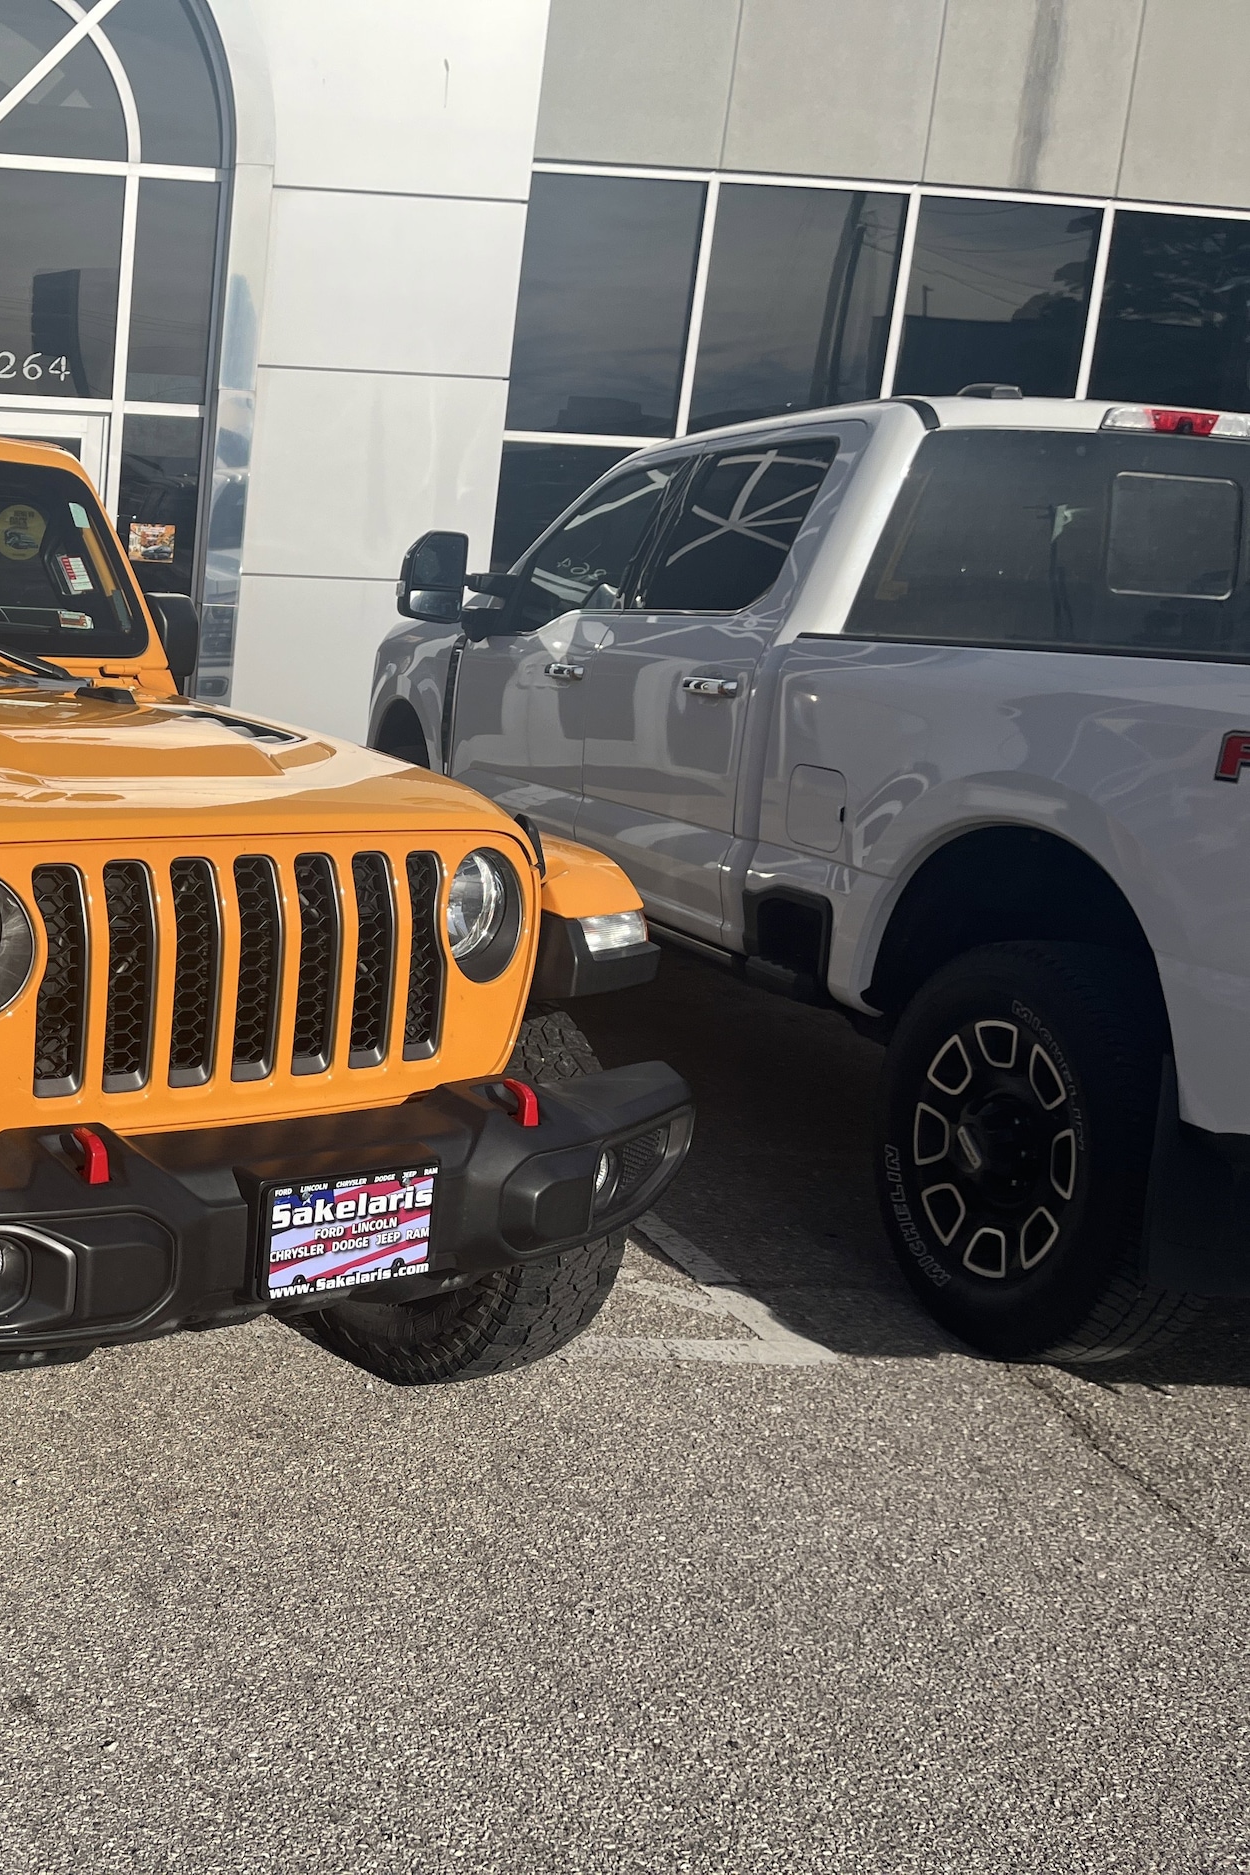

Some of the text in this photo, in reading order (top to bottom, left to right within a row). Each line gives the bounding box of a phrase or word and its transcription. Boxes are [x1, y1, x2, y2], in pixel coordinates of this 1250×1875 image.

[275, 1167, 439, 1197] FORD LINCOLN CHRYSLER DODGE JEEP RAM
[272, 1186, 434, 1229] Sakelaris
[884, 1144, 950, 1287] MICHELIN
[270, 1227, 430, 1263] CHRYSLER DODGE JEEP RAM
[314, 1217, 398, 1240] FORD LINCOLN
[269, 1262, 429, 1300] www.Sakelaris.com
